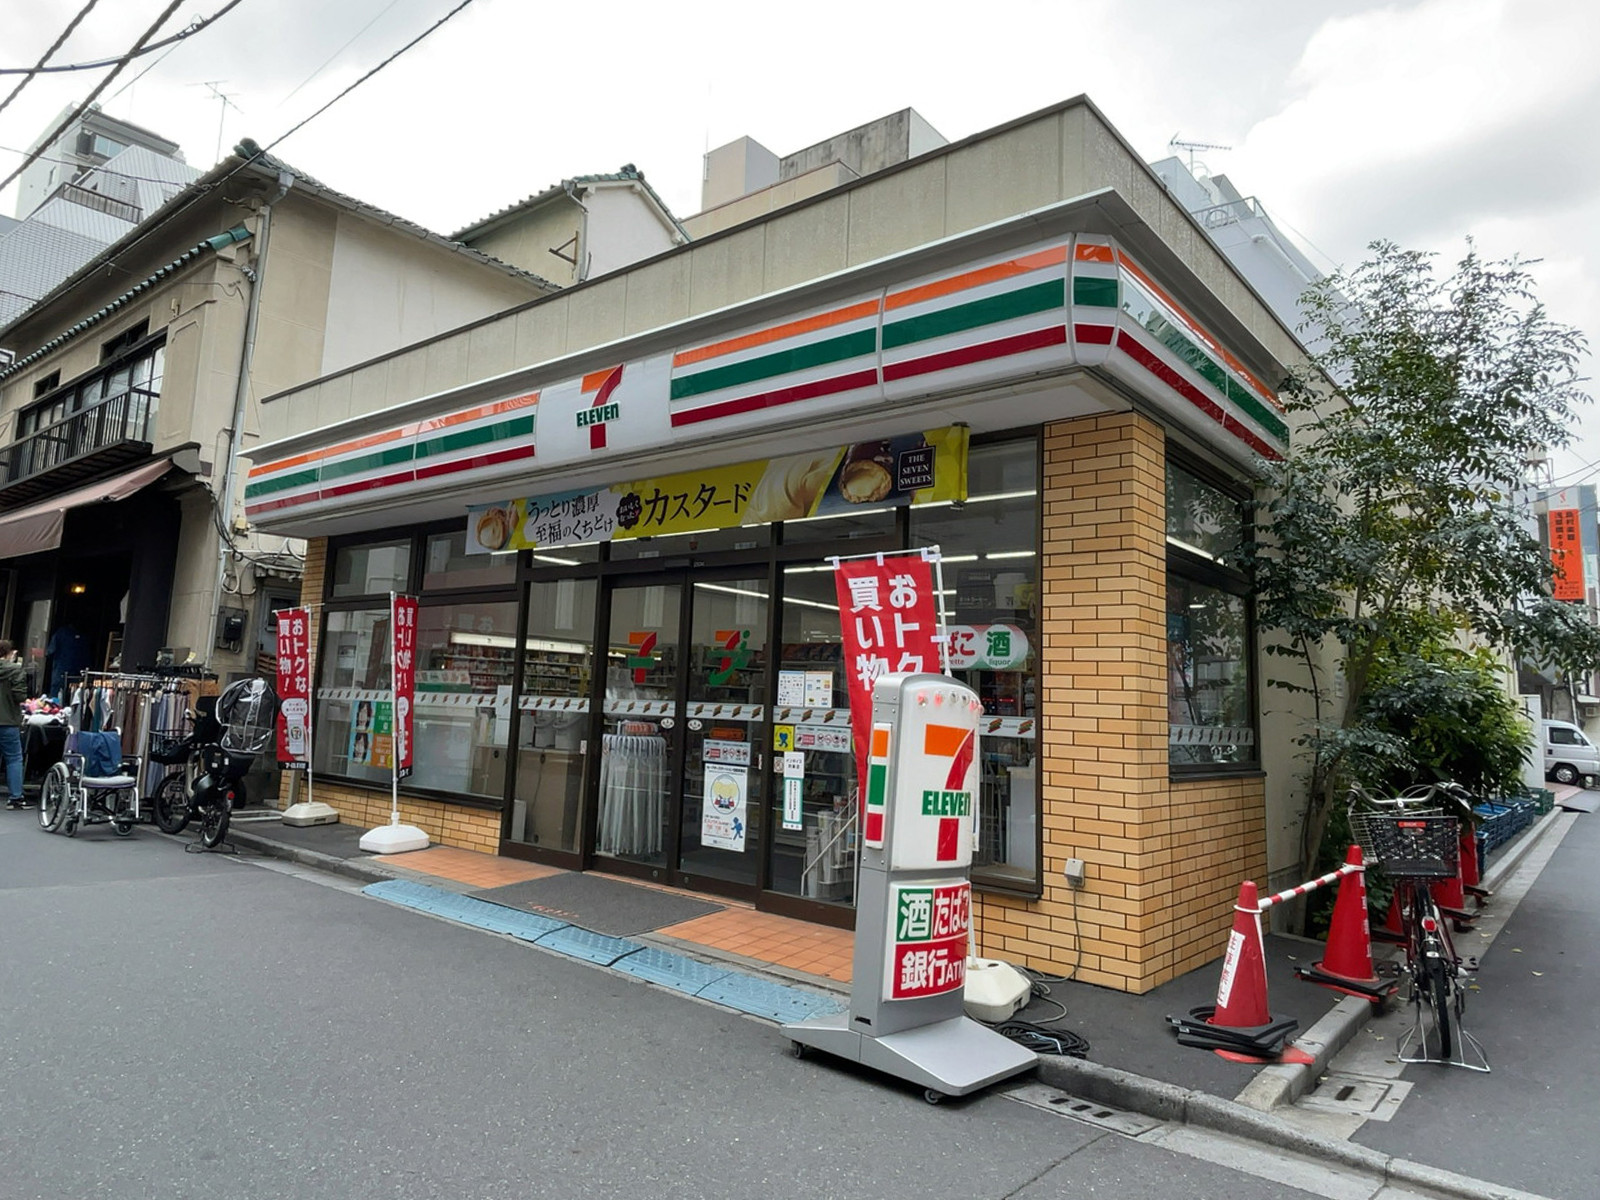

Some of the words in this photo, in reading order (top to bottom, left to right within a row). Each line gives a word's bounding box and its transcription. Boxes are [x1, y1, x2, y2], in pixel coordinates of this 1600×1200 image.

[902, 464, 929, 475] SEVEN
[908, 454, 926, 463] THE
[899, 475, 932, 486] SWEETS
[527, 493, 600, 524] うっとり濃厚
[643, 482, 752, 528] カスタード
[535, 513, 613, 545] 至福のくちどけ
[292, 618, 307, 693] おトクな
[939, 630, 976, 657] ばこ
[986, 631, 1011, 657] 酒
[988, 658, 1011, 667] liquor
[899, 892, 932, 940] 酒
[933, 888, 969, 937] たばこ
